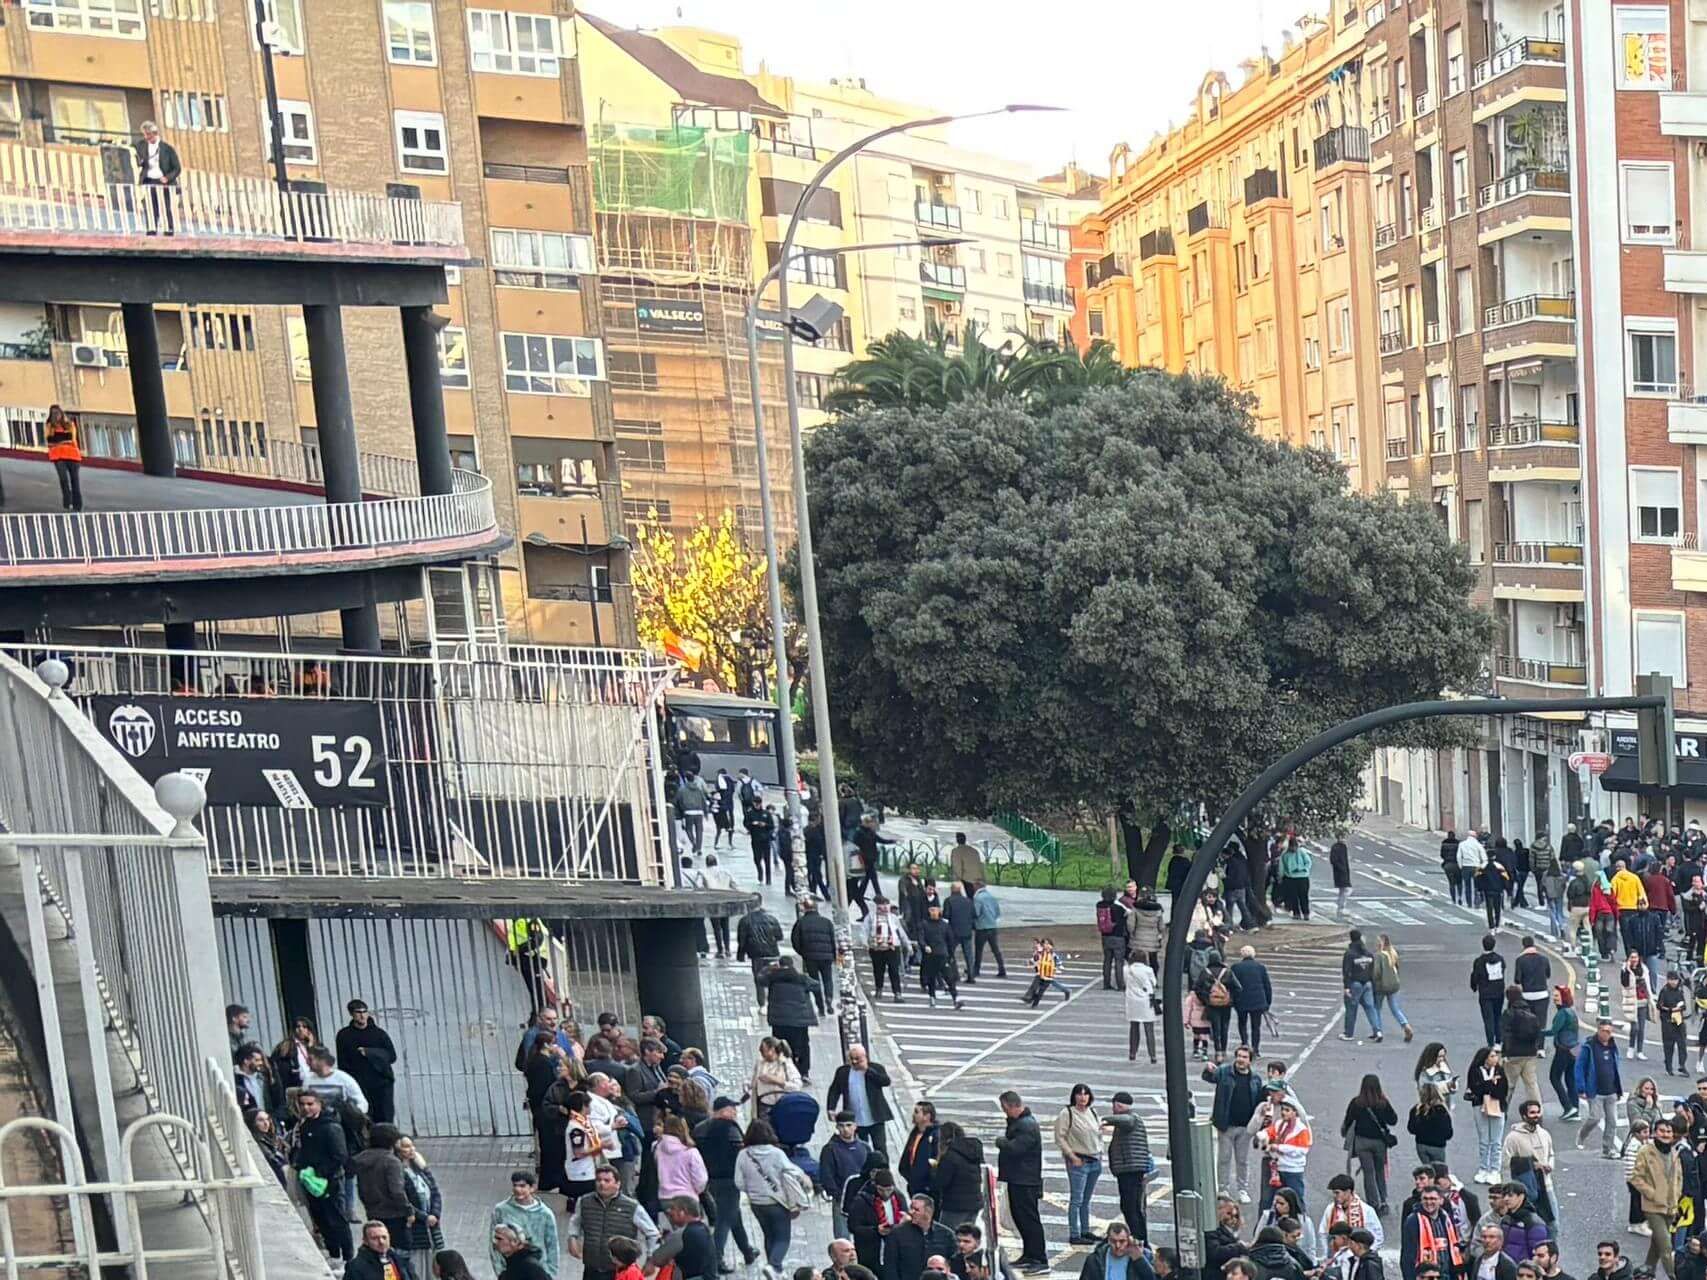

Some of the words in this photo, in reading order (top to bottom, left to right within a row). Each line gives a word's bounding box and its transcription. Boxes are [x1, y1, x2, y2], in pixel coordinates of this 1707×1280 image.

[650, 308, 704, 322] VALSECO
[174, 708, 243, 728] ACCESO
[176, 731, 281, 751] ANFITEATRO
[313, 736, 376, 788] 52
